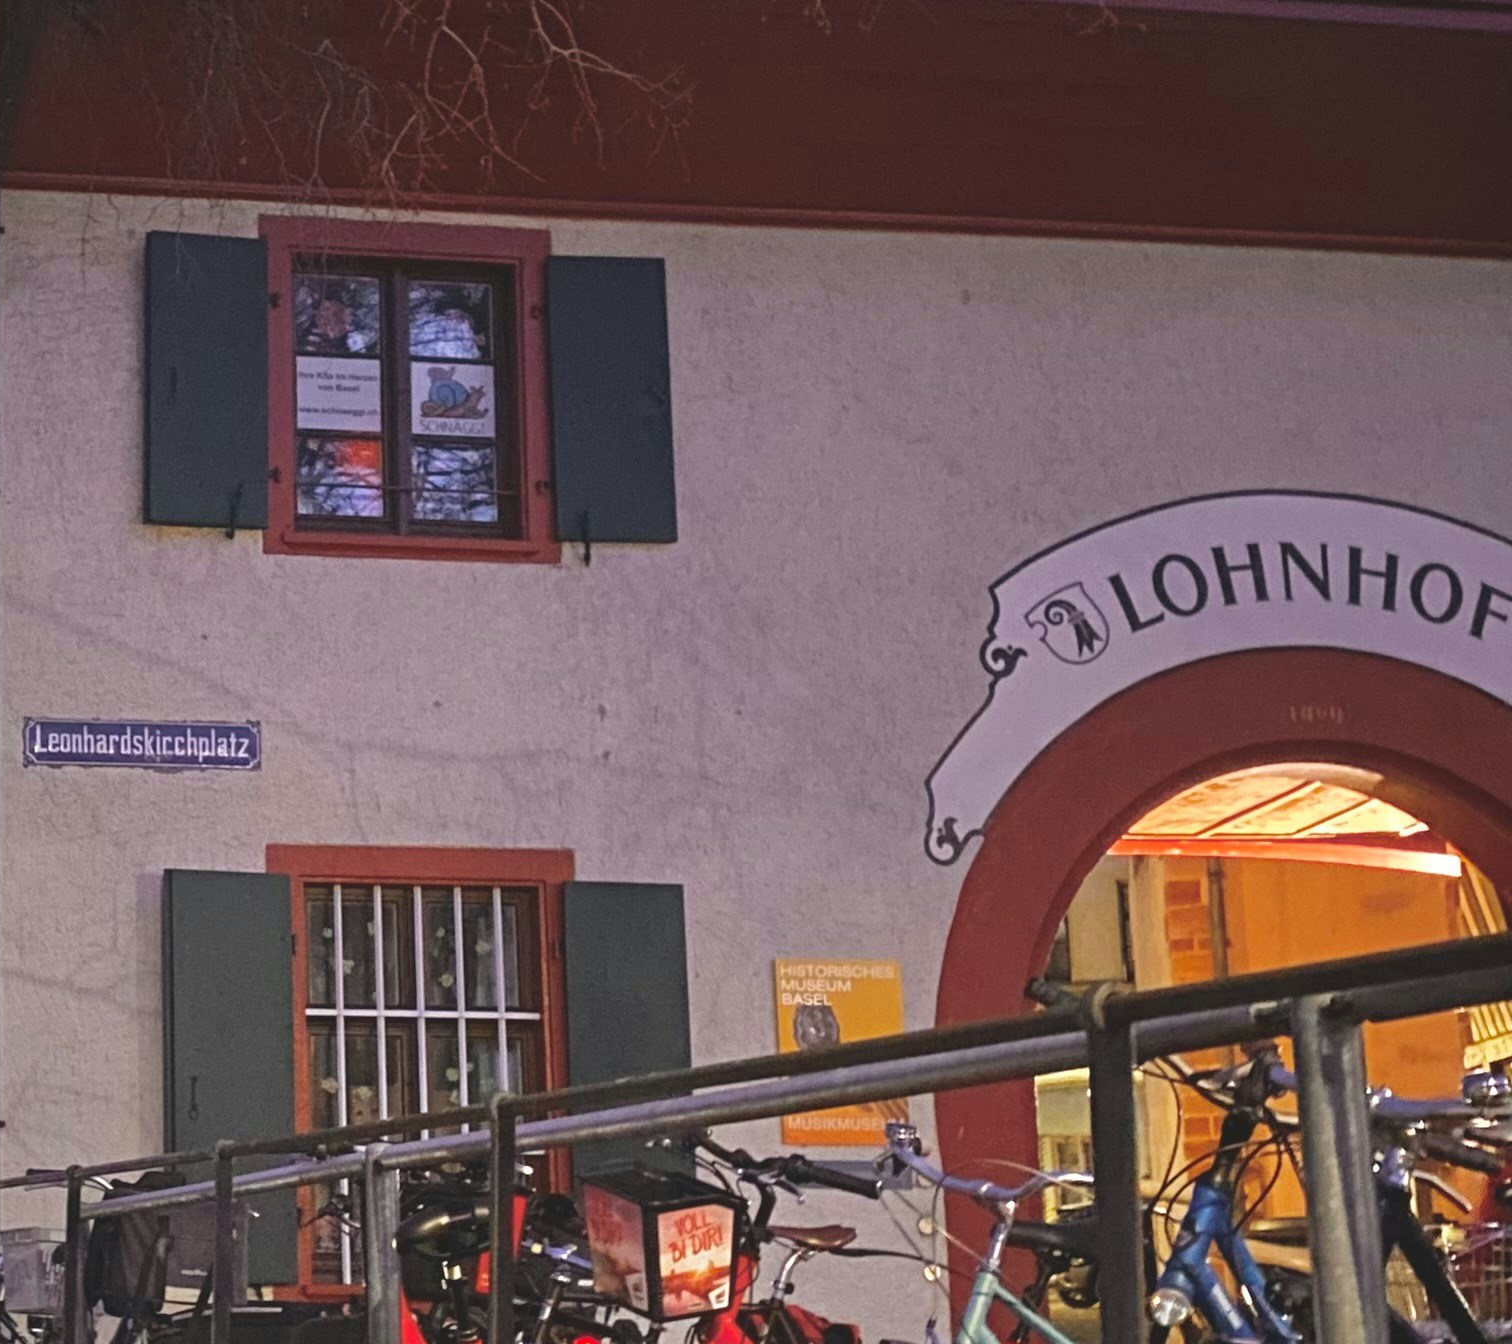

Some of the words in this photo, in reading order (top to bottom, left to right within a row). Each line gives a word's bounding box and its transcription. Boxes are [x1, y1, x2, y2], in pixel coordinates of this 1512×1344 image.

[1107, 540, 1512, 641] LOHNHOF
[34, 723, 250, 763] Leonhardskirchplatz
[780, 964, 895, 979] HISTORISCHES
[781, 978, 852, 992] MUSEUM
[782, 992, 833, 1006] BASEL
[787, 1116, 906, 1131] MUSIKMUSE
[674, 1212, 713, 1237] VOLL
